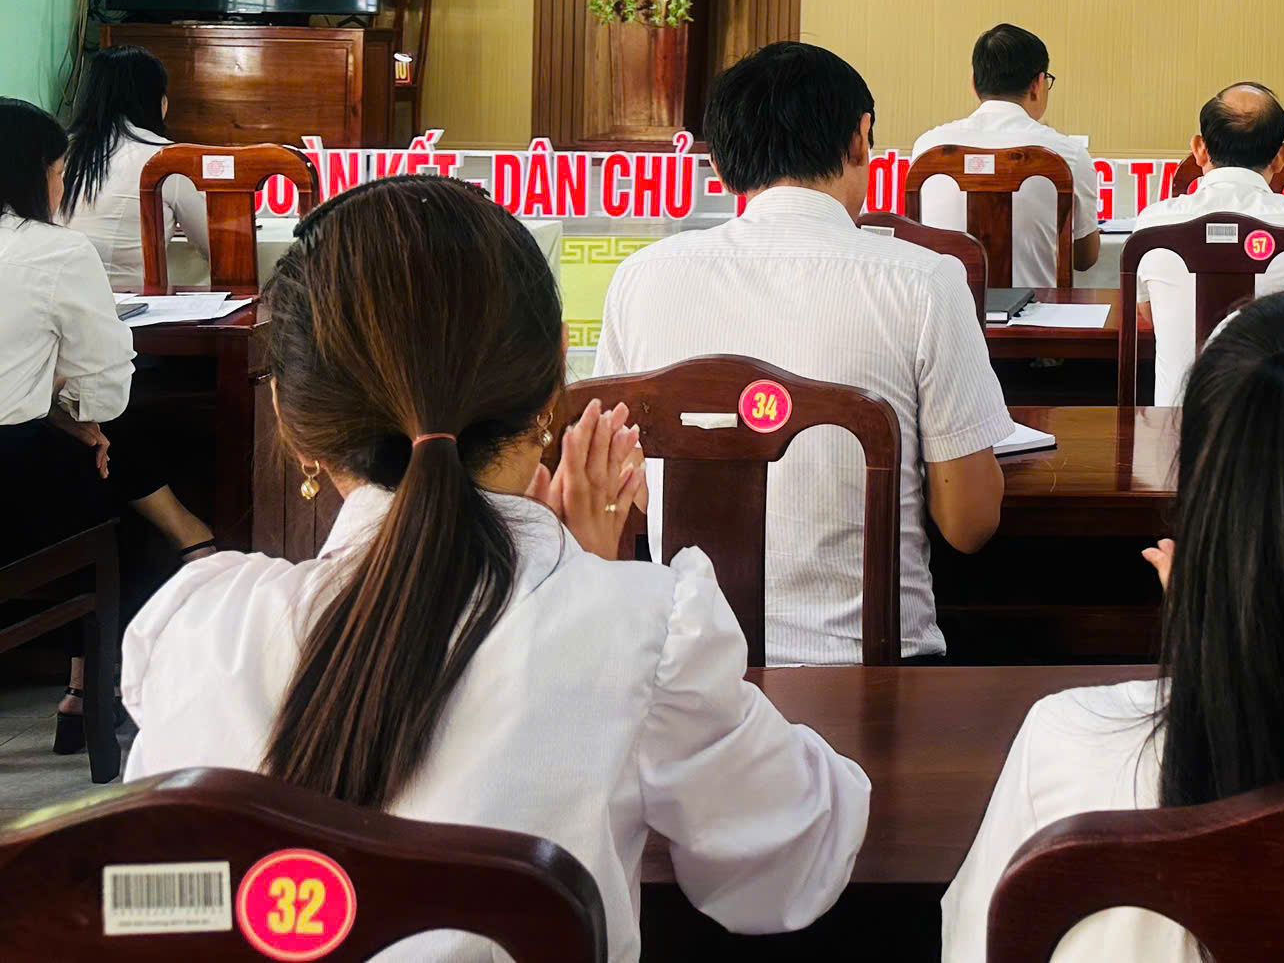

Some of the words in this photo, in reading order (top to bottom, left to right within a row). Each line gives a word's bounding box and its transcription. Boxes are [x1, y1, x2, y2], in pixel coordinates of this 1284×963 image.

[494, 141, 587, 216] DÂN
[602, 133, 694, 218] CHỦ
[1252, 237, 1267, 253] 57
[752, 392, 778, 421] 34
[267, 877, 326, 934] 32
